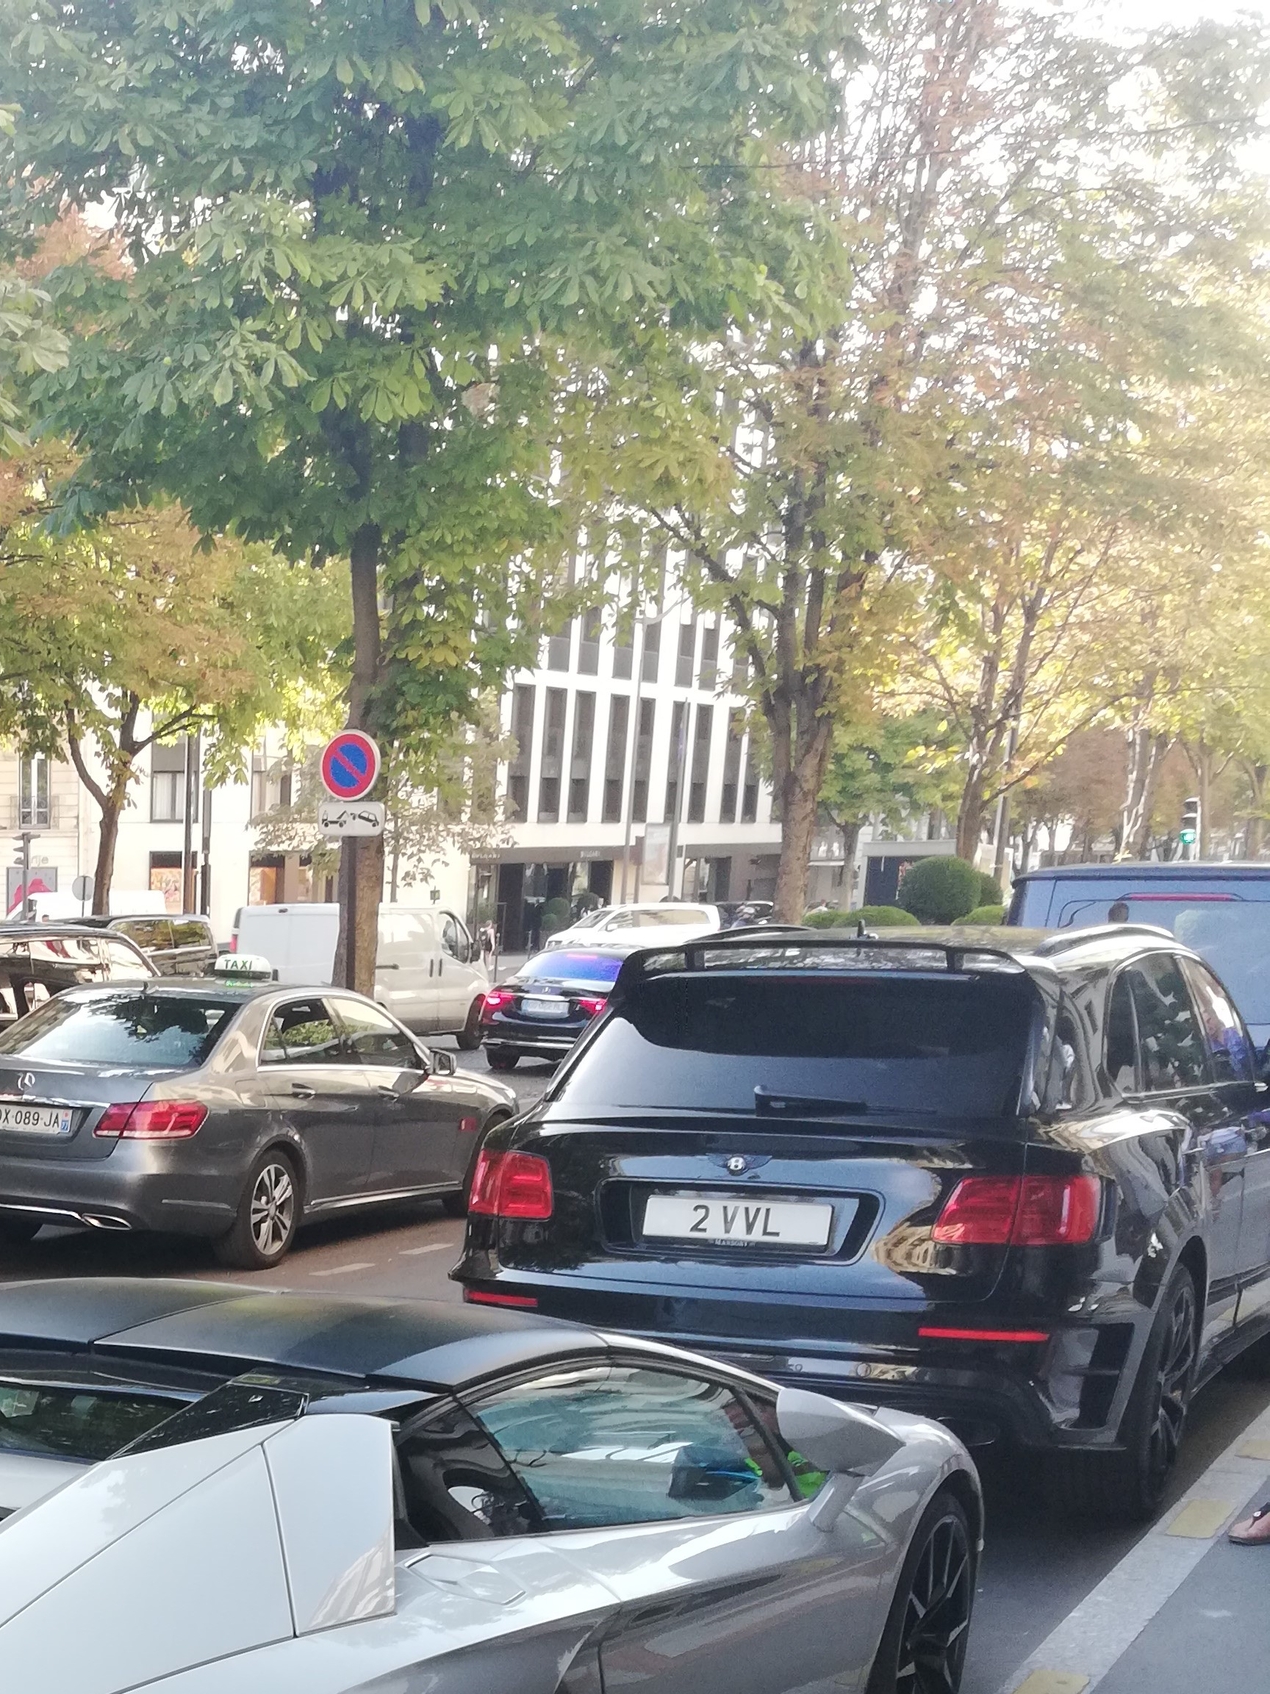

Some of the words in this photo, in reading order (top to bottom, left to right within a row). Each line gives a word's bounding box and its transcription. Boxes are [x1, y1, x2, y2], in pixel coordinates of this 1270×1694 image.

[225, 959, 253, 970] TAXI
[689, 1204, 710, 1233] 2
[722, 1205, 780, 1237] VVL
